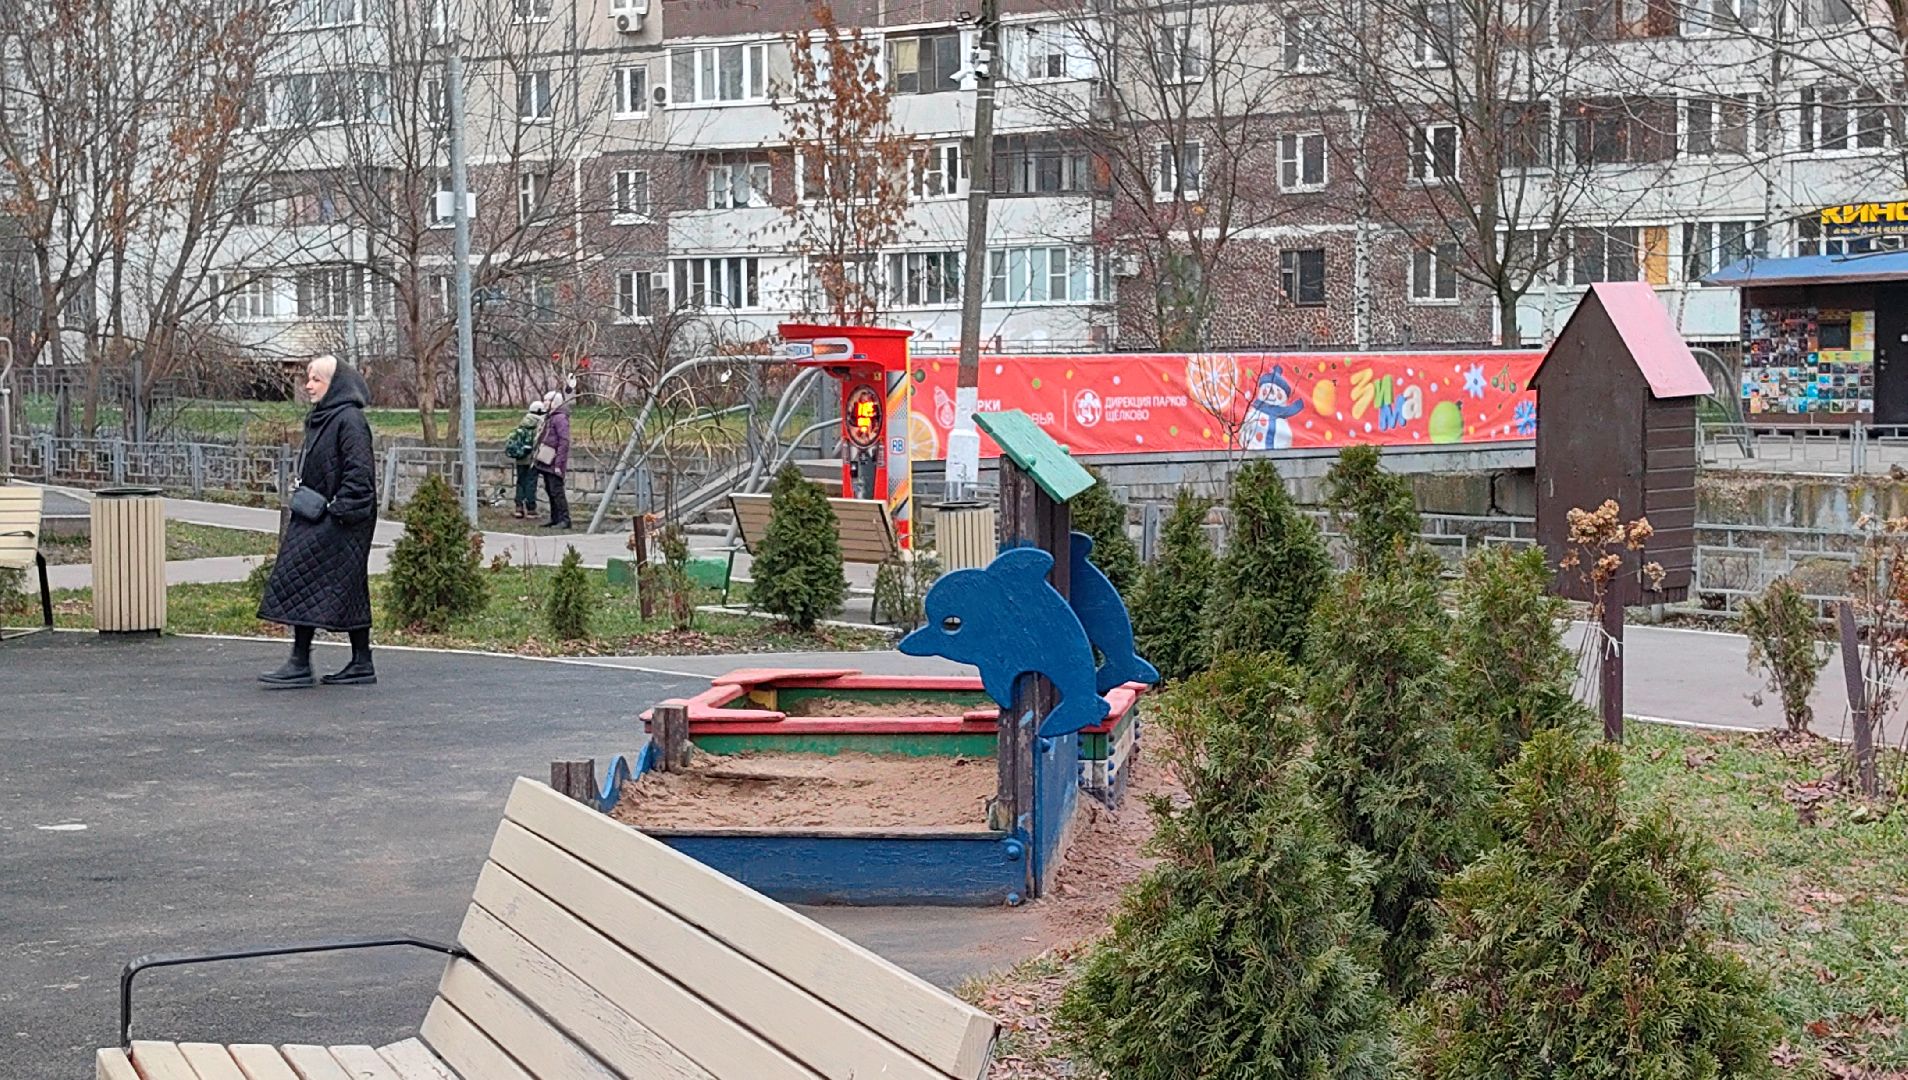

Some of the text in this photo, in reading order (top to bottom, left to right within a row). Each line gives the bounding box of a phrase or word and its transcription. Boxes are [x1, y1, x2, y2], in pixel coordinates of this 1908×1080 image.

[1104, 395, 1188, 408] ДИРЕКЦИЯ ПАРКОВ
[1105, 409, 1149, 422] ЩЁЛКОВО
